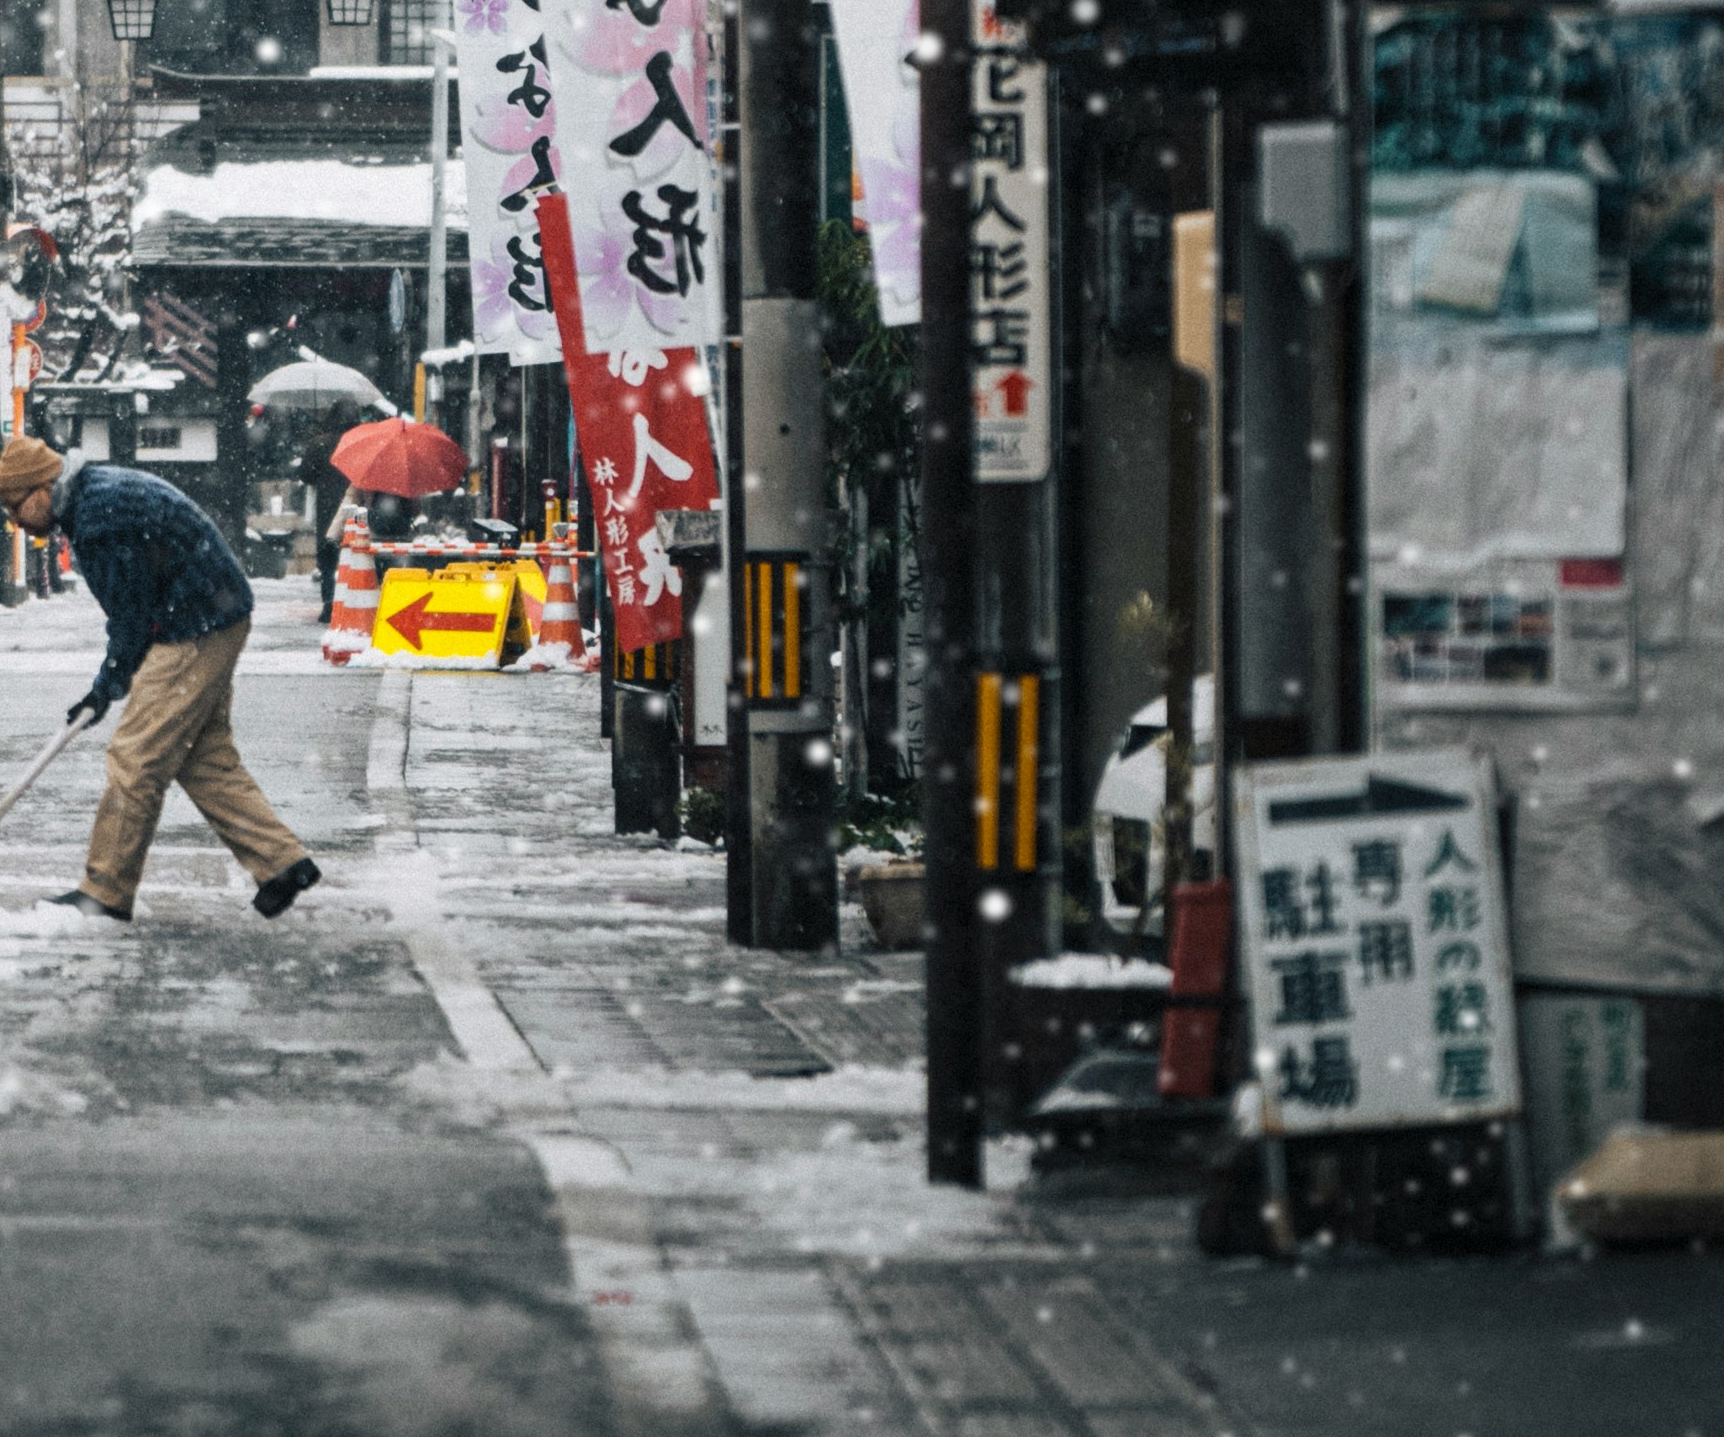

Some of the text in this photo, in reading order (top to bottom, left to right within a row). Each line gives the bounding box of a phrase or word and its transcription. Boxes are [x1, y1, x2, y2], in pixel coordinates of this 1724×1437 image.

[593, 456, 637, 606] 林人形工房
[1261, 858, 1361, 1110] 駐車場
[1353, 838, 1417, 988] 専用
